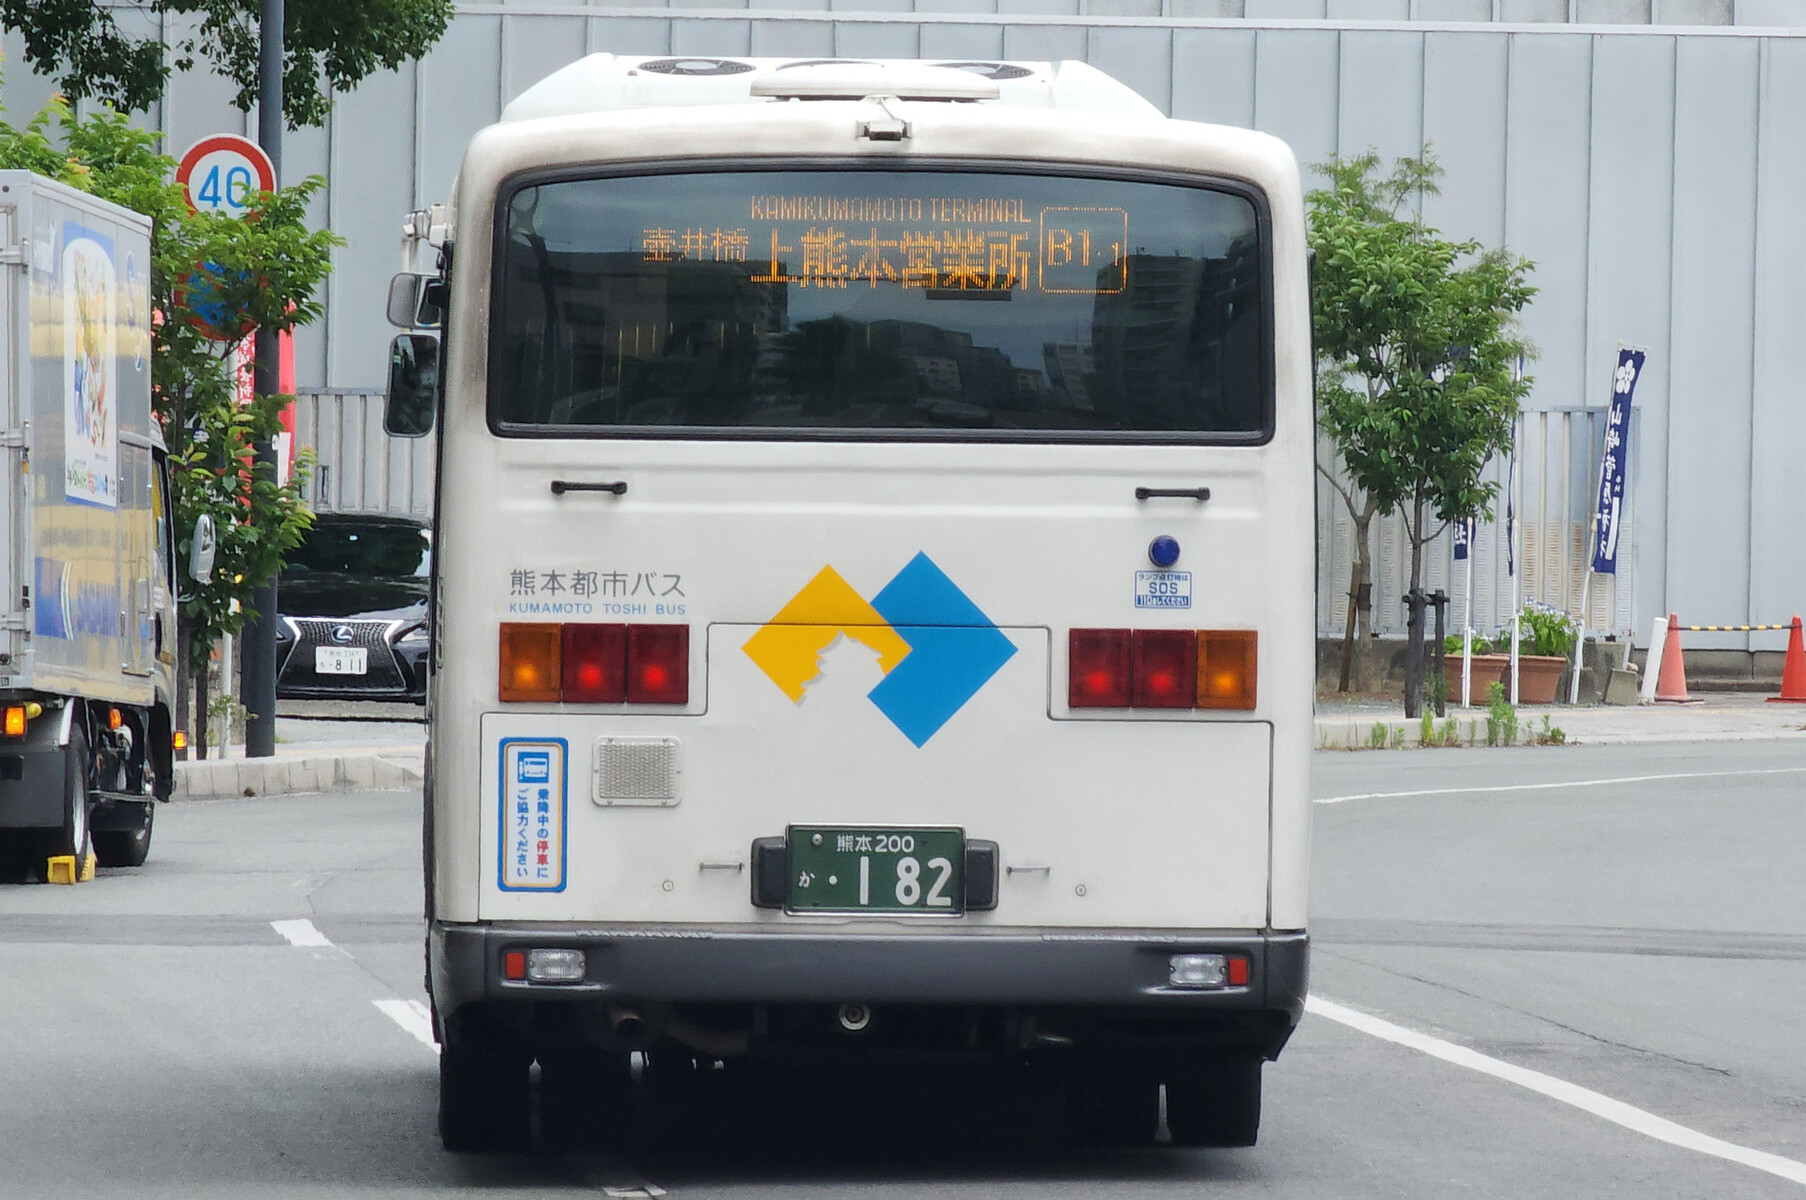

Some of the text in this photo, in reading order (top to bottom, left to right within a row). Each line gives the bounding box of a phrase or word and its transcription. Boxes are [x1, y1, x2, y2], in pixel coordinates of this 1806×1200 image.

[198, 165, 251, 208] 40
[751, 195, 1031, 223] KAMIKUMAMOTO TERMINAL
[750, 226, 1031, 290] 上熊本営業所
[510, 568, 686, 599] 熊本都市バス
[1149, 582, 1178, 594] SOS
[509, 602, 686, 616] KUMAMOTO TOSHI BUS
[798, 870, 816, 888] か
